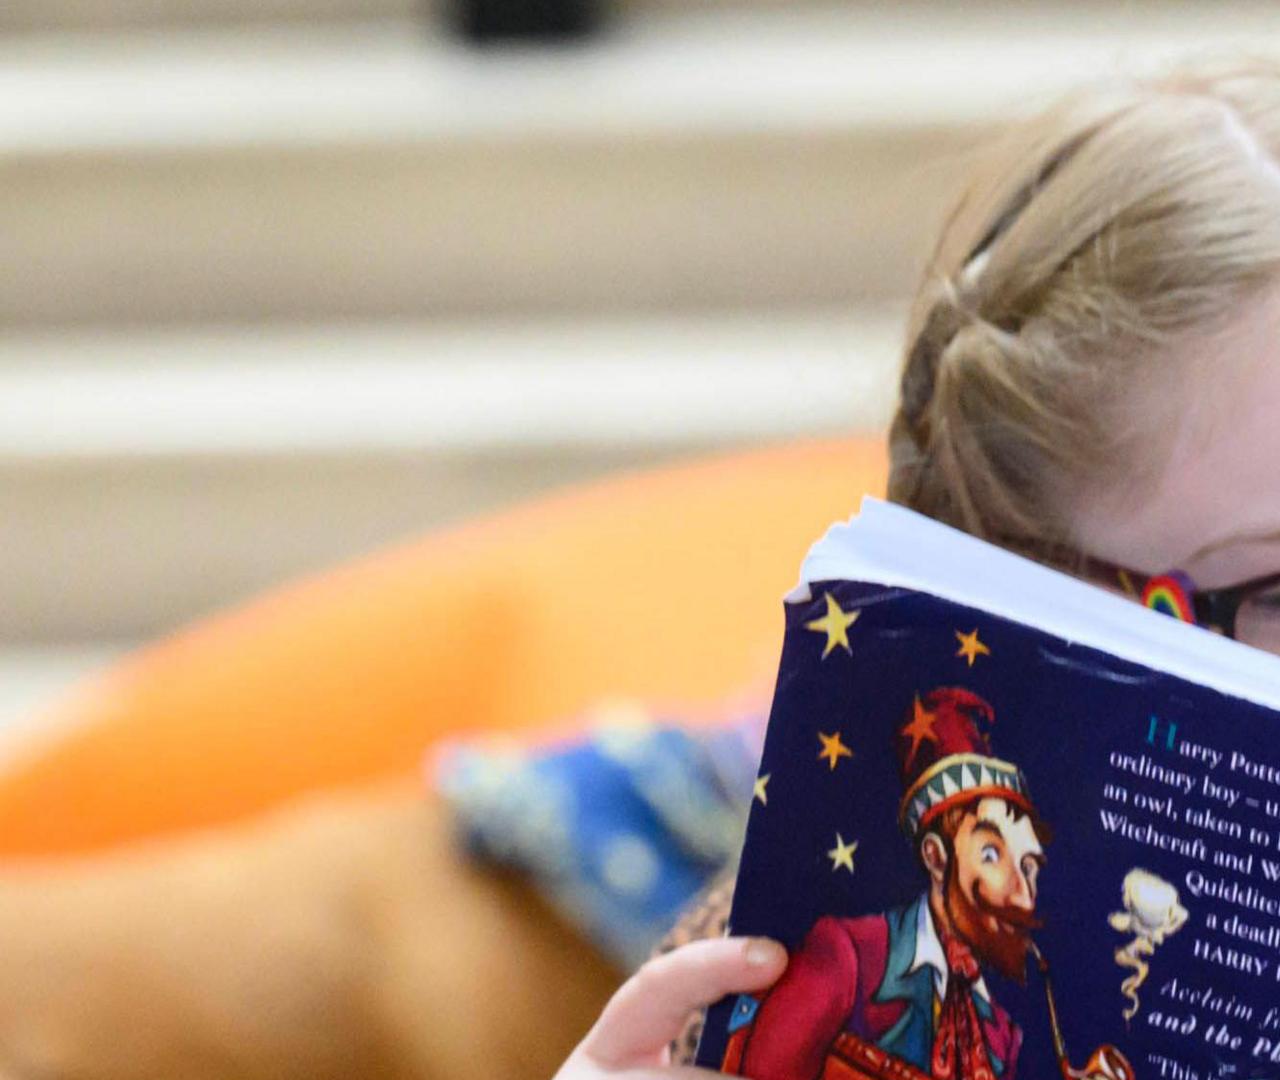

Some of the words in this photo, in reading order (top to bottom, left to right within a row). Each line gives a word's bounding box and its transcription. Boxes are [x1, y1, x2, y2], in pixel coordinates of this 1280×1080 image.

[1147, 718, 1223, 770] Harry
[1110, 752, 1196, 794] ordinary
[1203, 774, 1240, 808] boy
[1104, 783, 1127, 803] an
[1134, 793, 1178, 822] owl,
[1185, 808, 1242, 839] taken
[1249, 828, 1270, 847] to
[1100, 809, 1207, 861] Witchcraft
[1214, 850, 1253, 875] and
[1206, 913, 1217, 930] a
[1194, 939, 1268, 976] HARRY
[1160, 978, 1253, 1021] Acclaim
[1148, 1011, 1196, 1035] and
[1205, 1024, 1242, 1050] the
